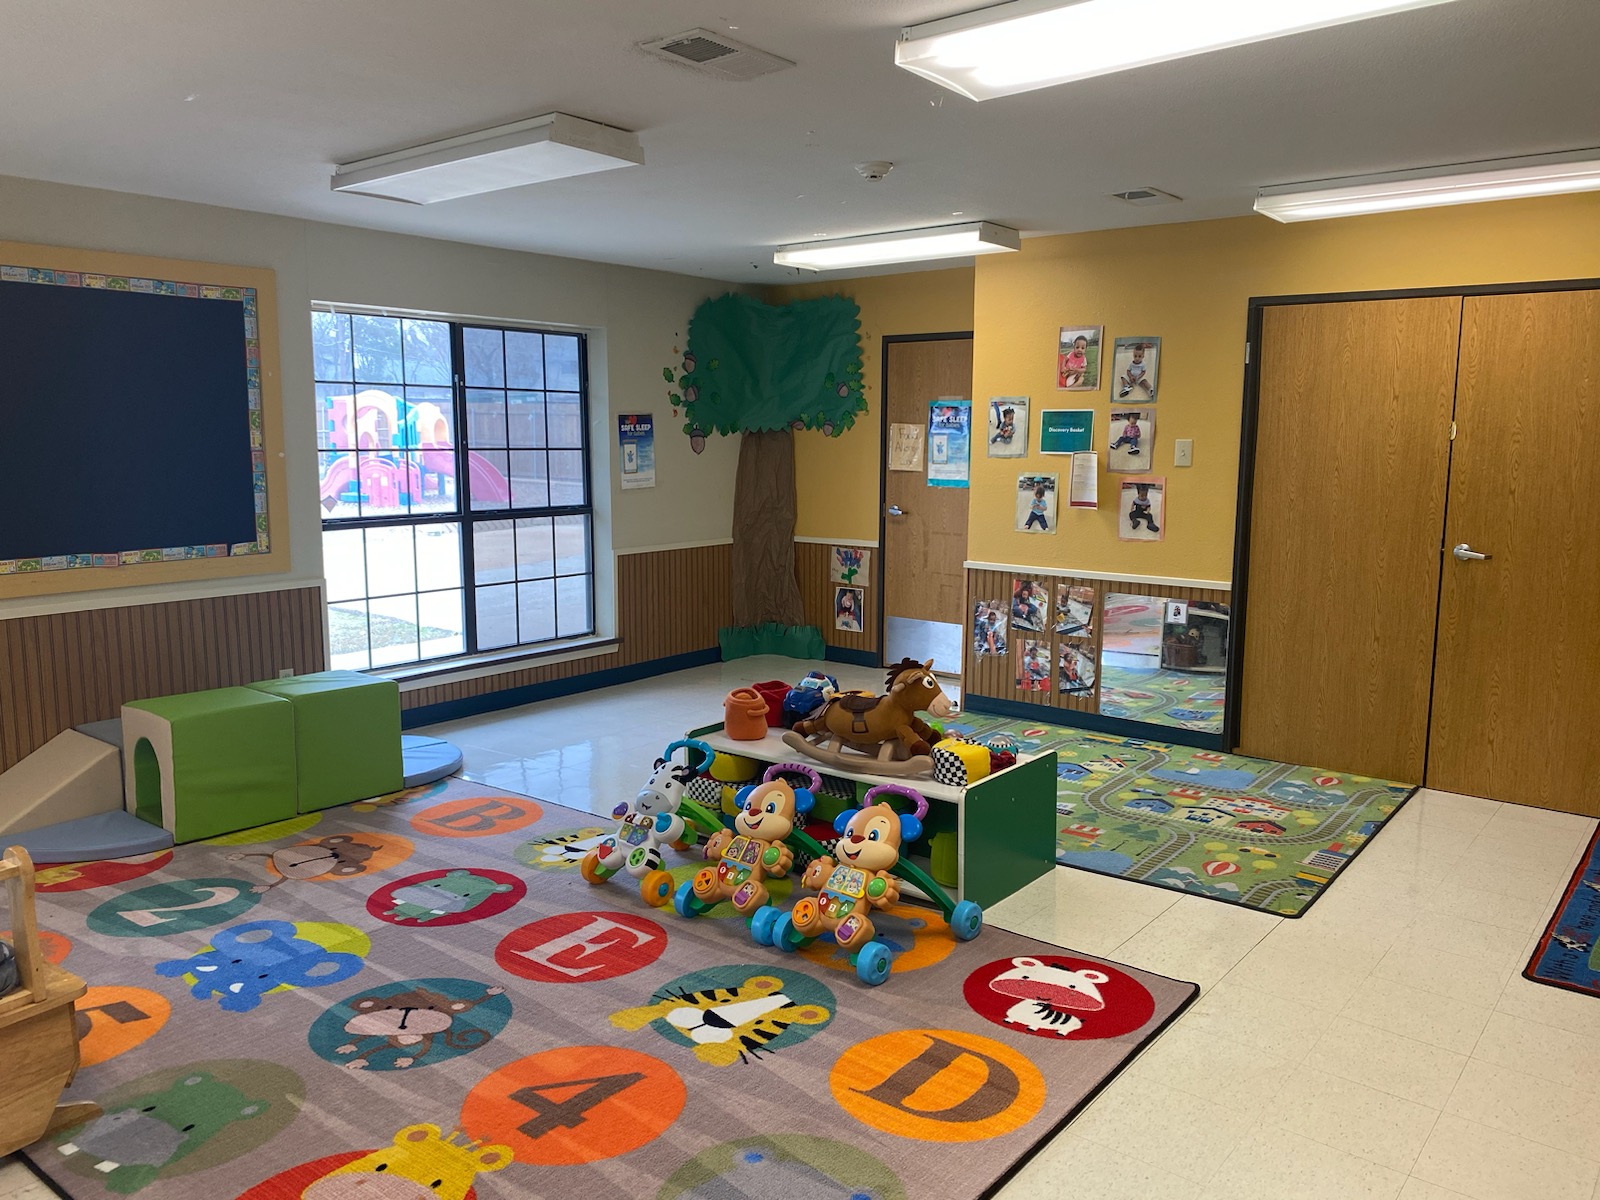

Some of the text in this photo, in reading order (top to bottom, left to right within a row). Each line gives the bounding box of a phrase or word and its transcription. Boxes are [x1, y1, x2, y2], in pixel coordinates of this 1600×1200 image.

[426, 799, 527, 831] B
[116, 886, 240, 928] 2
[510, 914, 657, 977] E
[508, 1071, 649, 1140] 4
[848, 1033, 1021, 1123] D
